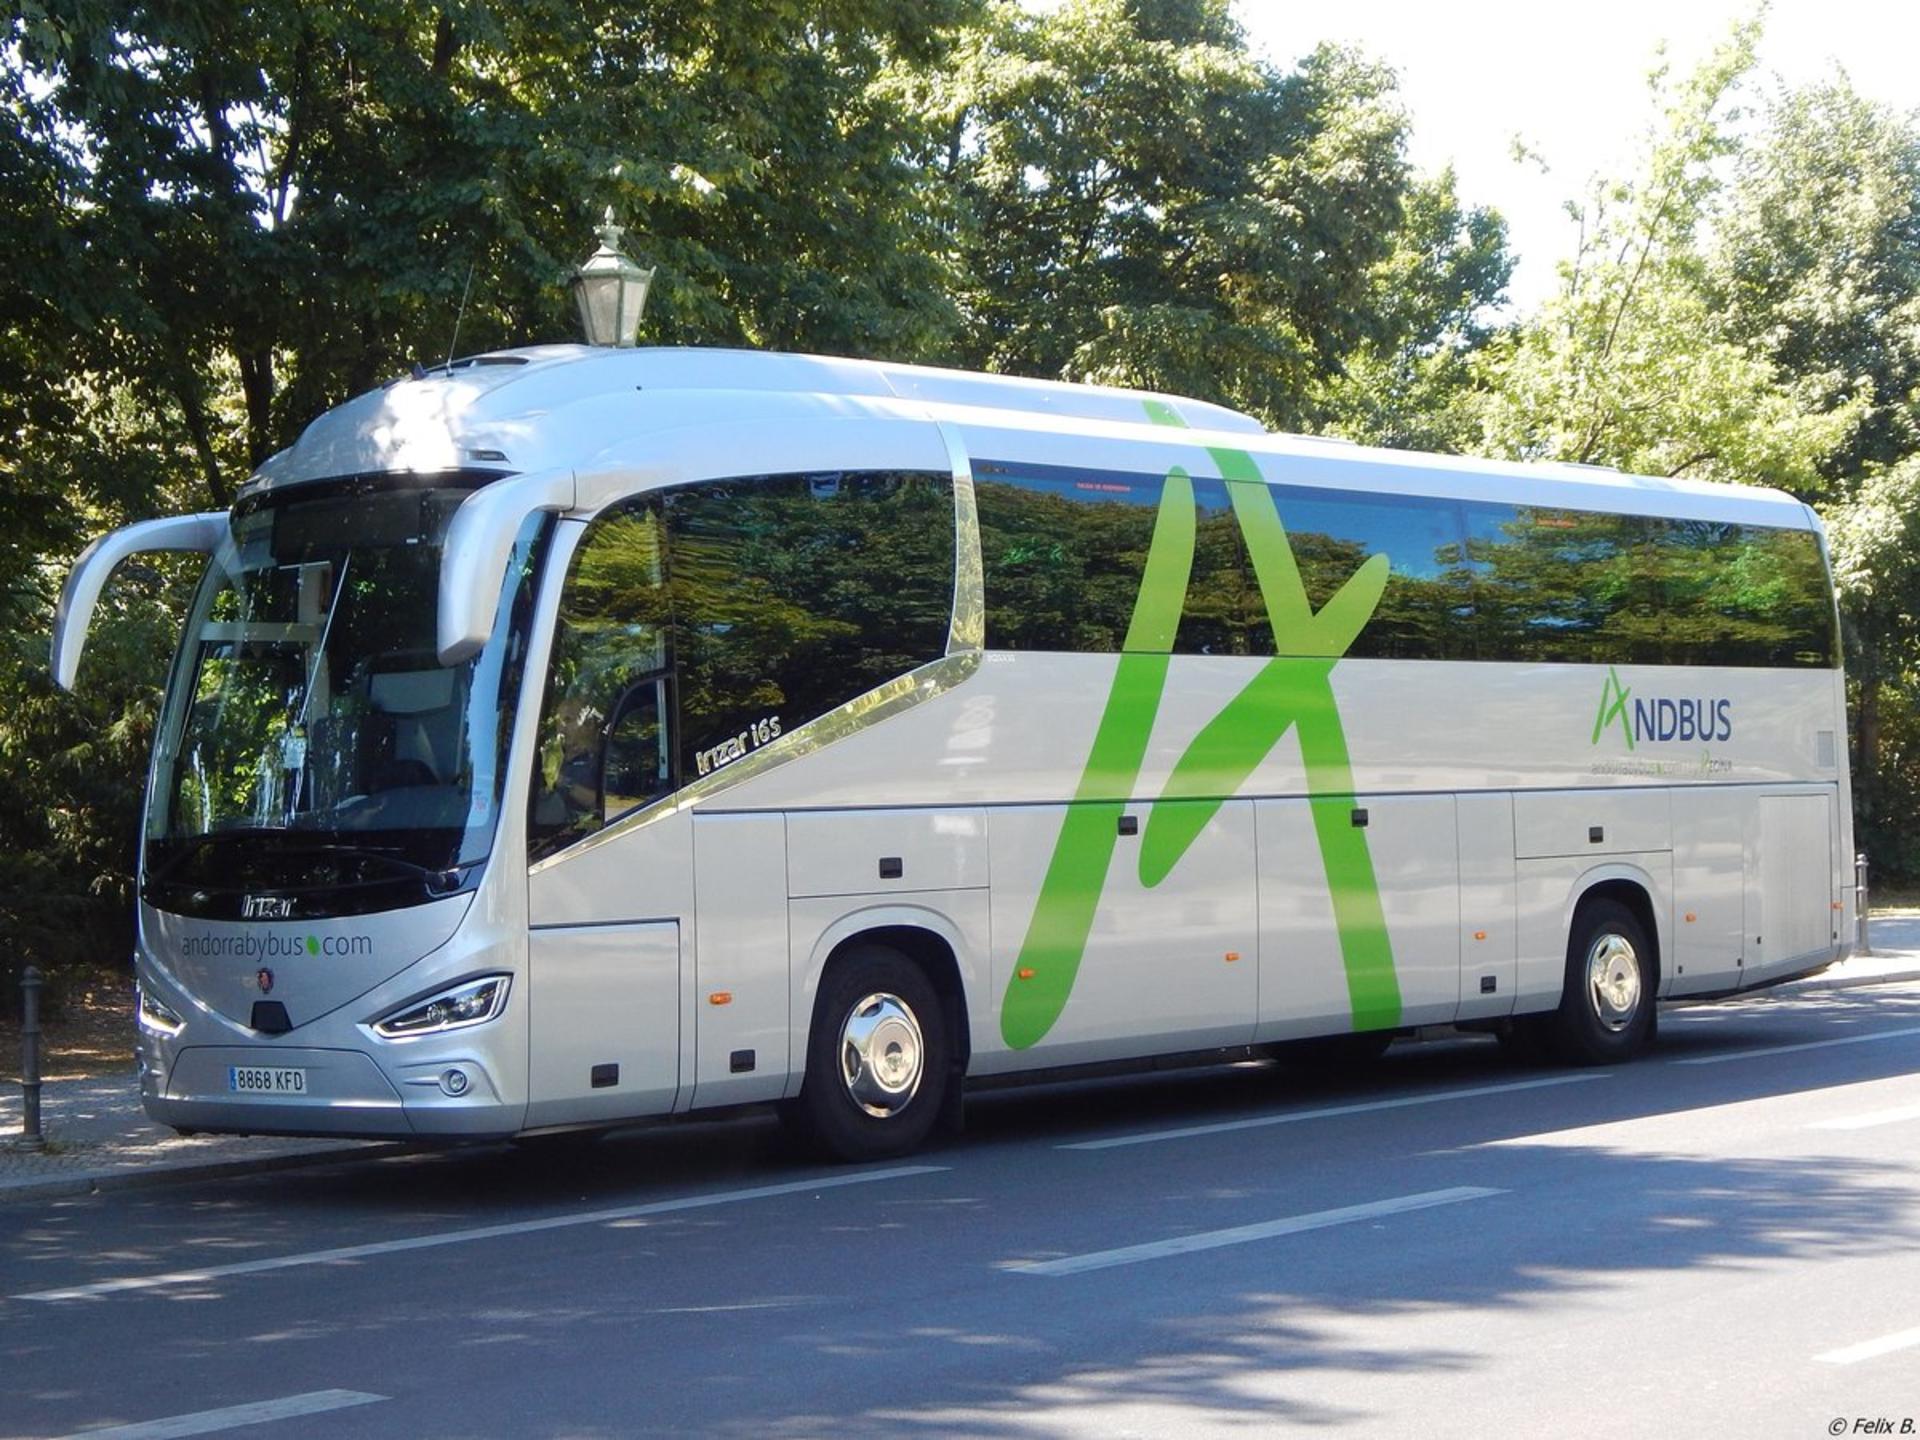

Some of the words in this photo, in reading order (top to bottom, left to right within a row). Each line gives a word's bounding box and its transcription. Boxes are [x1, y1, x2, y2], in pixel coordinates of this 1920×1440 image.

[1591, 666, 1732, 751] ANDBUS
[238, 1070, 272, 1089] 8868
[275, 1070, 304, 1091] KFD
